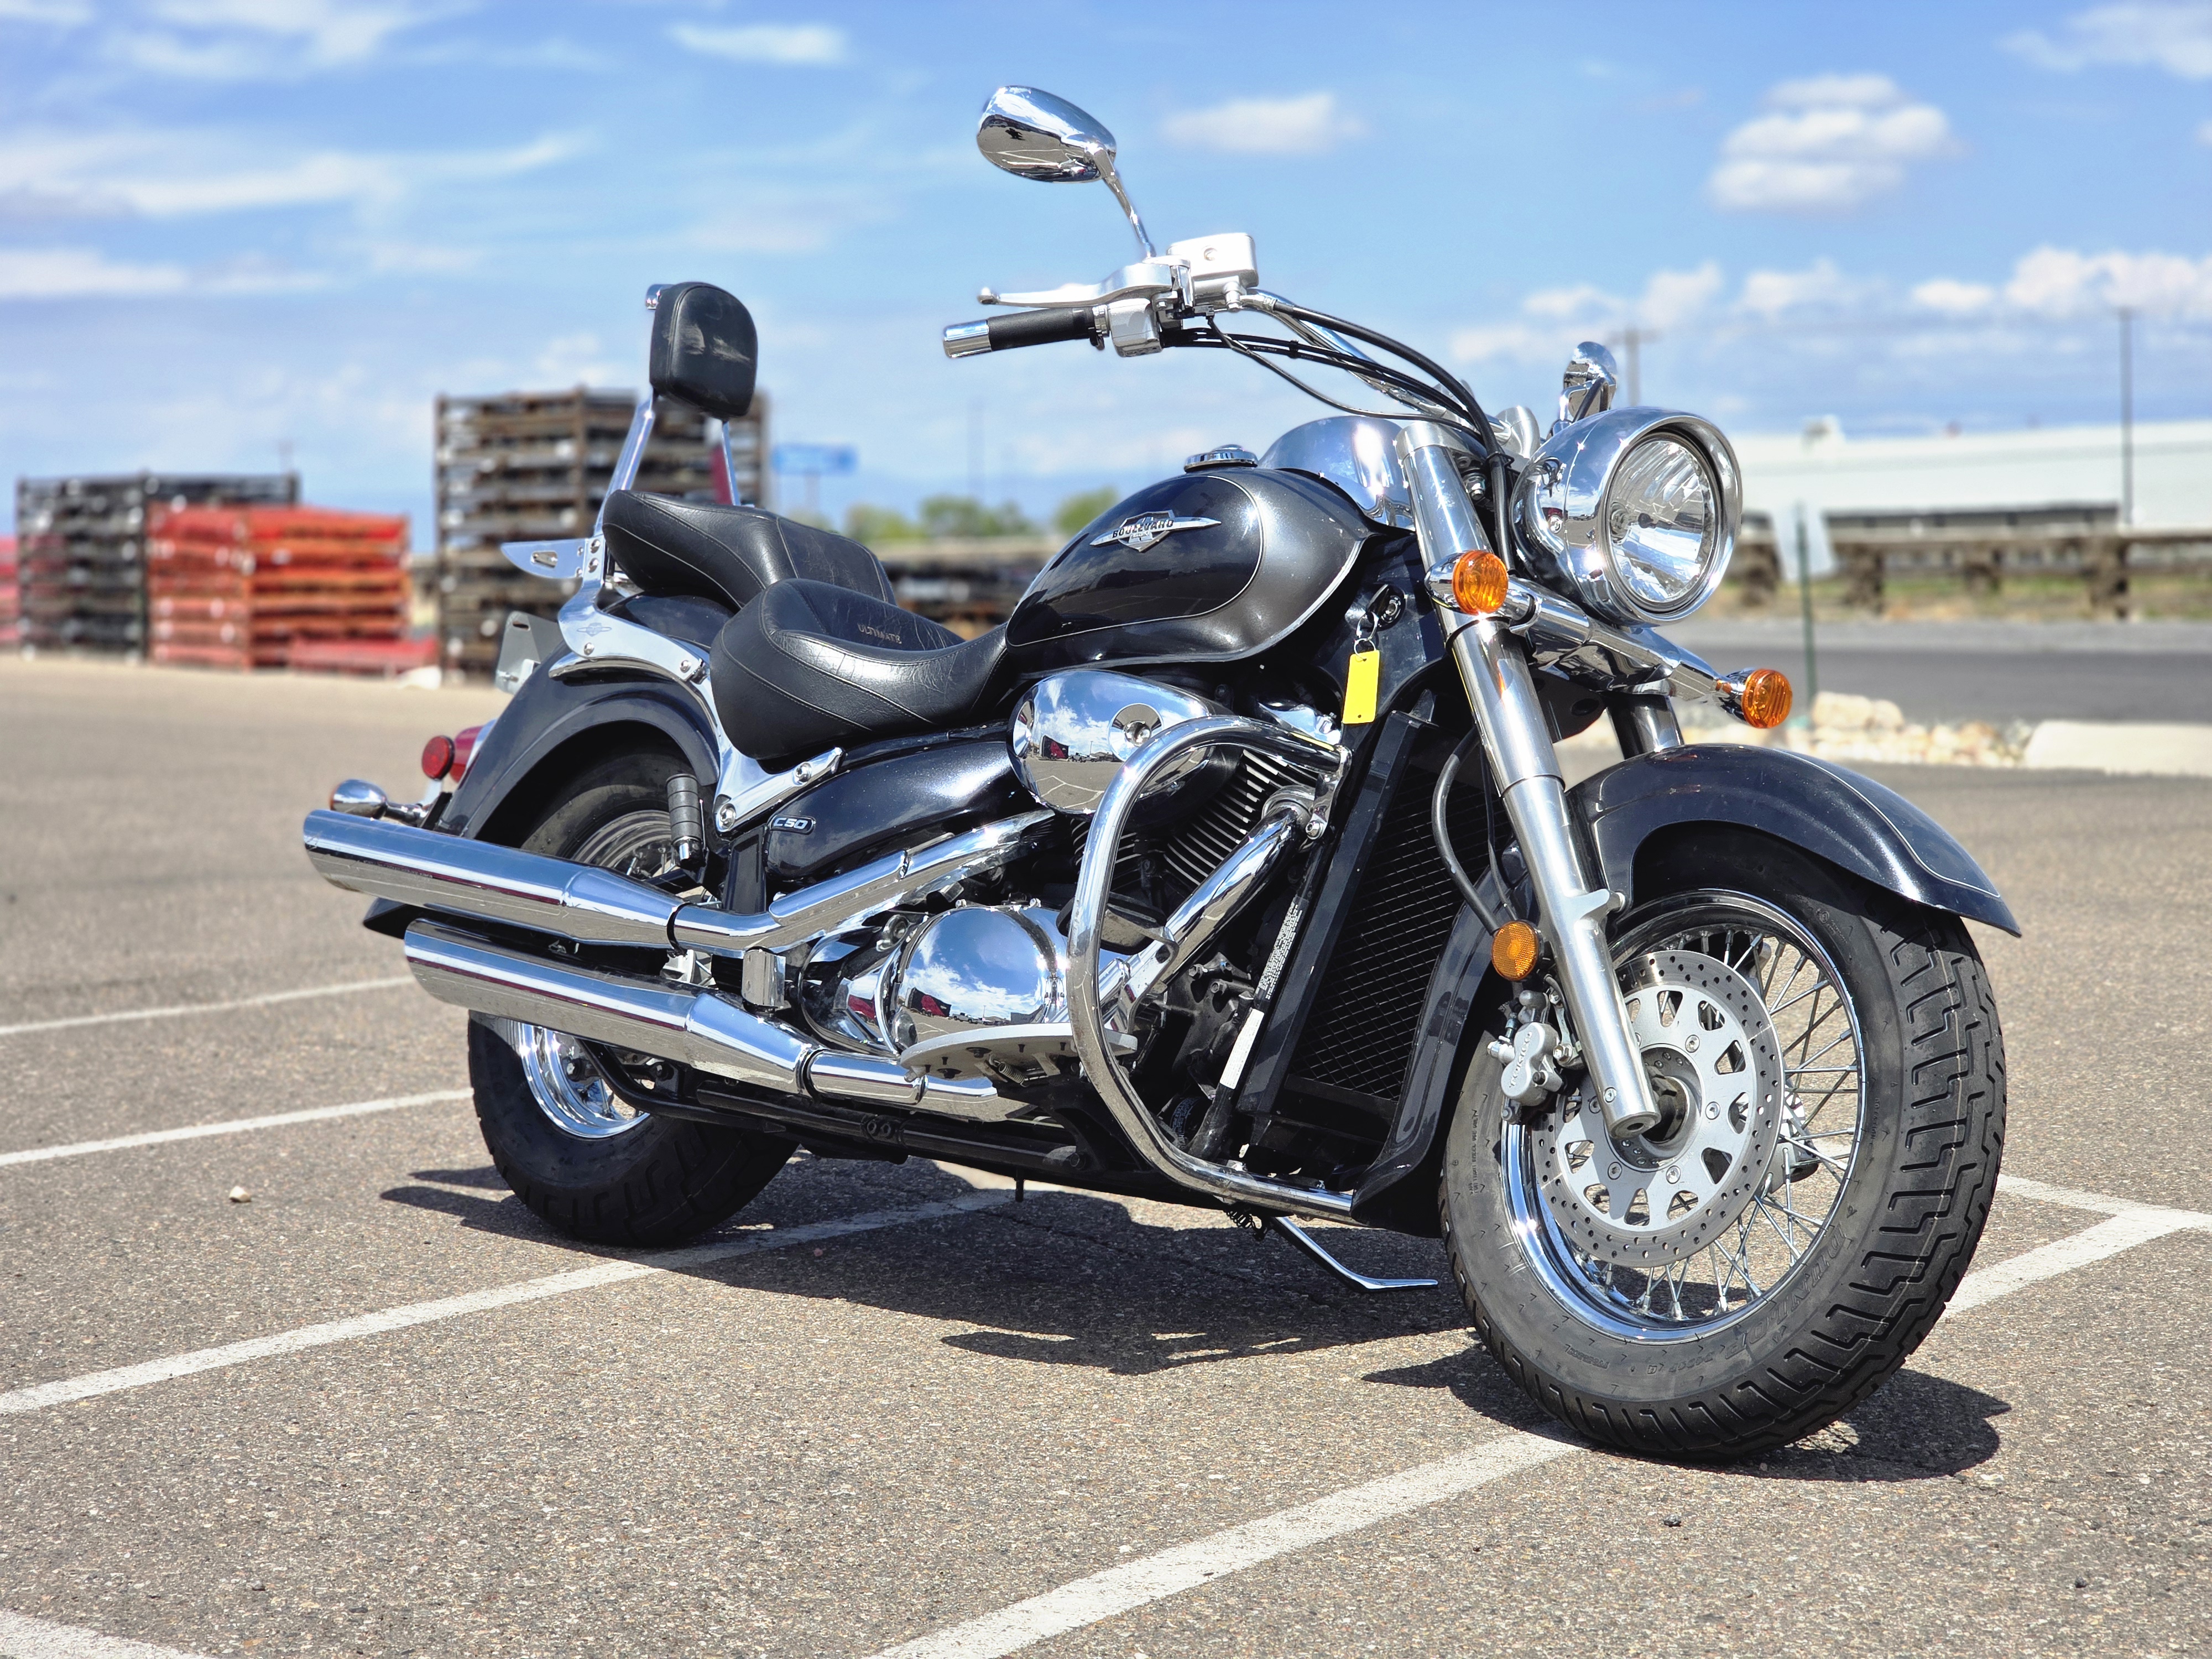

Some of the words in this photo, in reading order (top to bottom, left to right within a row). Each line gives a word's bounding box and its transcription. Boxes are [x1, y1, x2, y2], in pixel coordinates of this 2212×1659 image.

[1112, 519, 1174, 538] BOULEVARD
[773, 817, 808, 830] C50
[1725, 1223, 1847, 1360] DUNLOP
